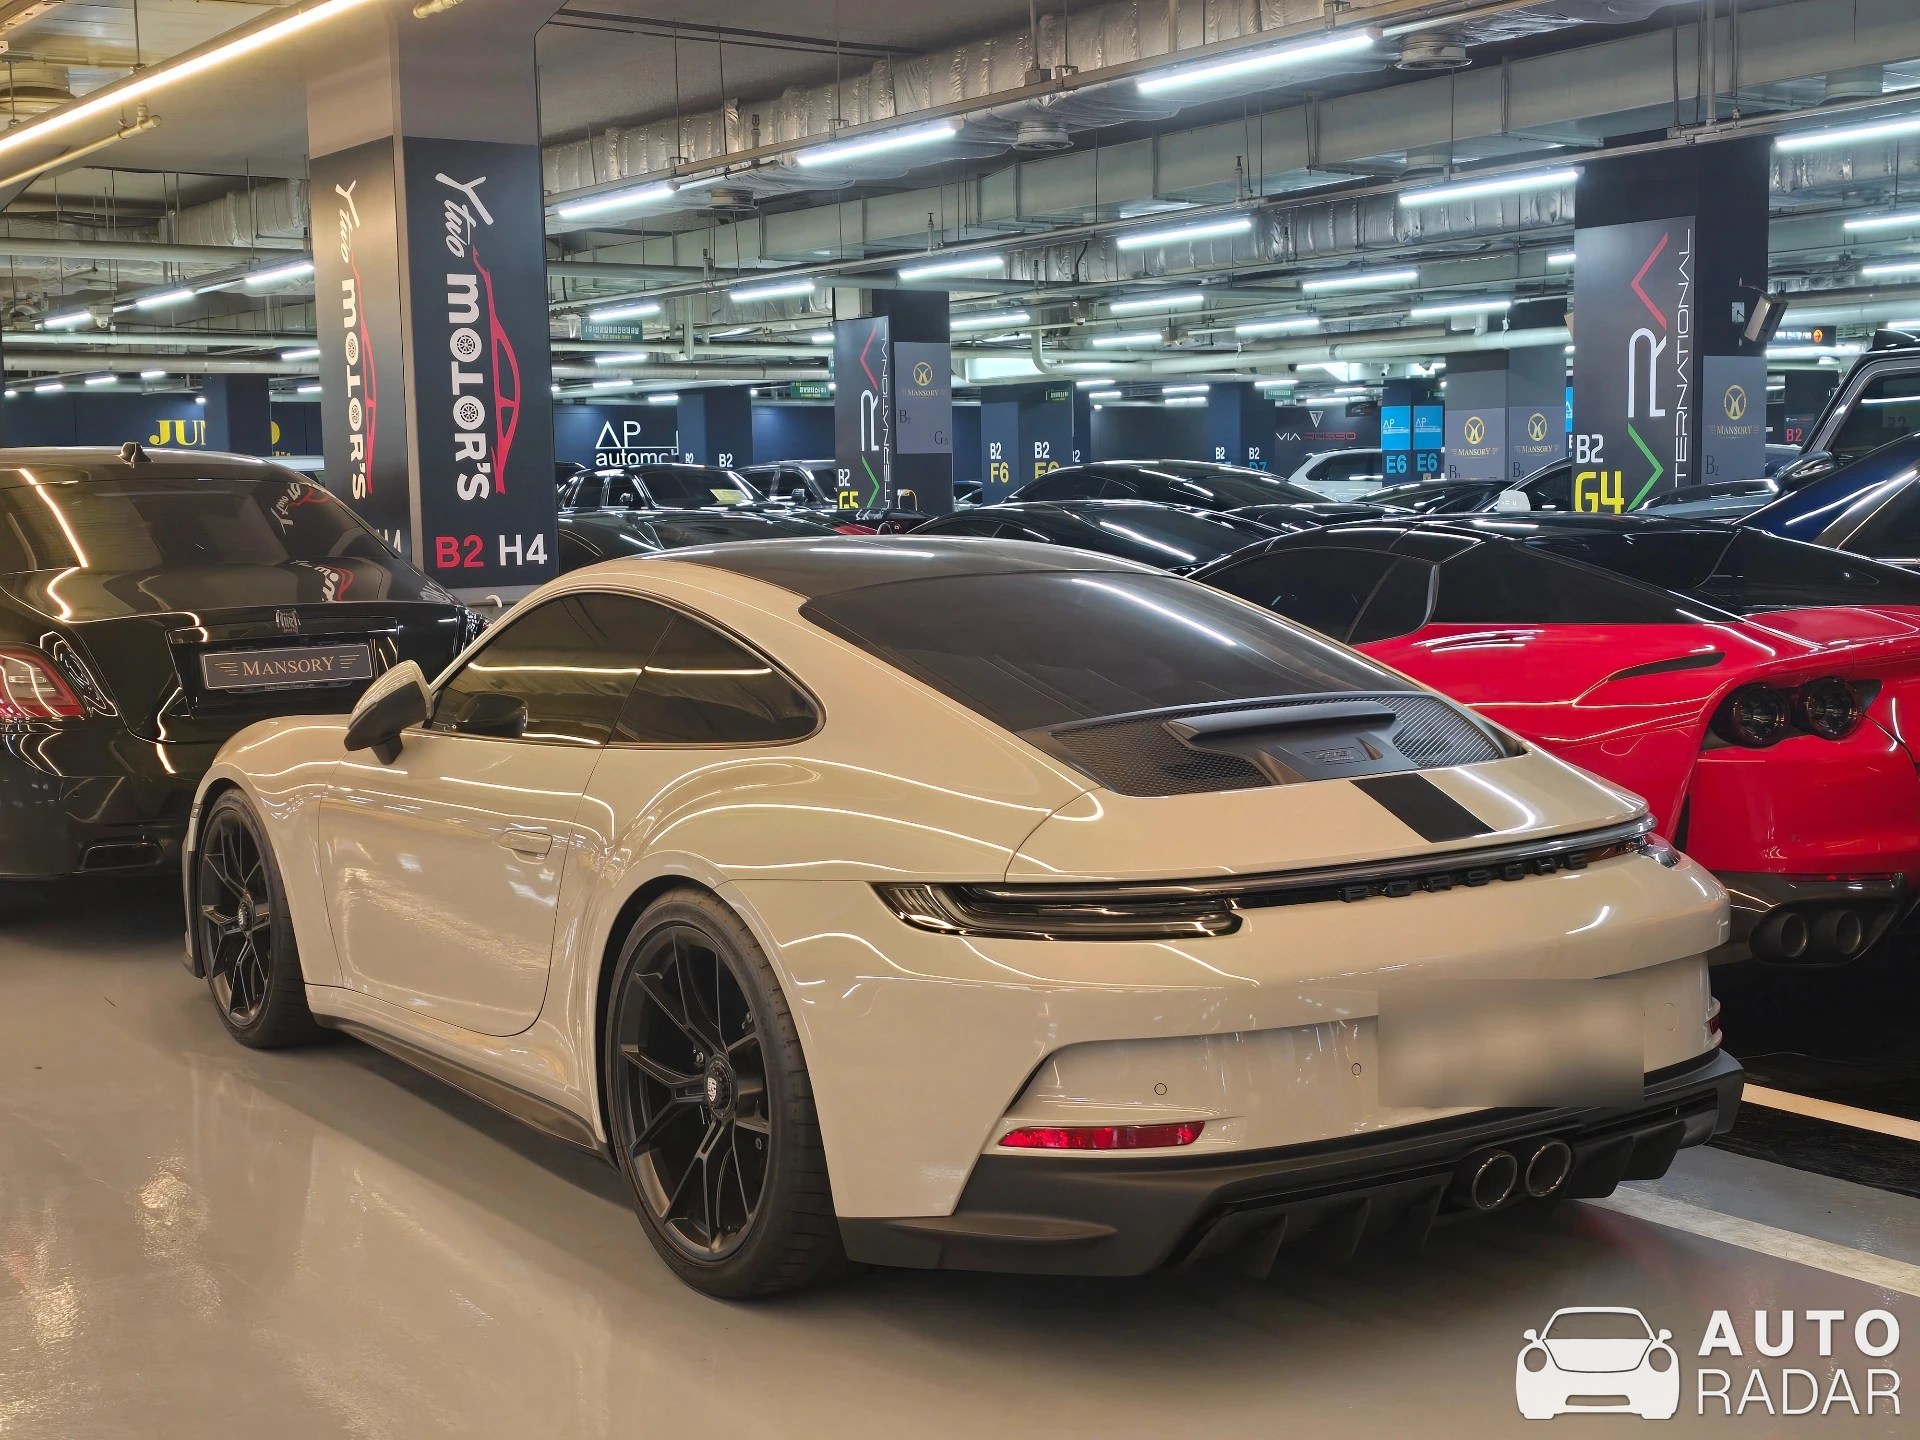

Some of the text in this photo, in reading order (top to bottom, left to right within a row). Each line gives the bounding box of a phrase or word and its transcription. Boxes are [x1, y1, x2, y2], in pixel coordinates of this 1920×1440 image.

[434, 172, 494, 259] Ytwo
[1275, 432, 1301, 441] VIA
[1786, 428, 1803, 442] B2
[989, 442, 1002, 460] B2
[1034, 441, 1050, 459] B2
[1215, 446, 1226, 460] B2
[1248, 446, 1260, 460] B2
[1458, 447, 1491, 456] MANSORY
[1576, 434, 1604, 464] B2
[718, 453, 734, 468] B2
[1386, 454, 1407, 474] E6
[1416, 452, 1438, 472] E6
[838, 468, 851, 487] B2
[990, 461, 1009, 483] F6
[1575, 470, 1625, 514] G4
[435, 534, 485, 569] B2
[498, 533, 548, 566] H4
[242, 656, 335, 677] MANSORY
[1338, 852, 1589, 903] PORSCHE
